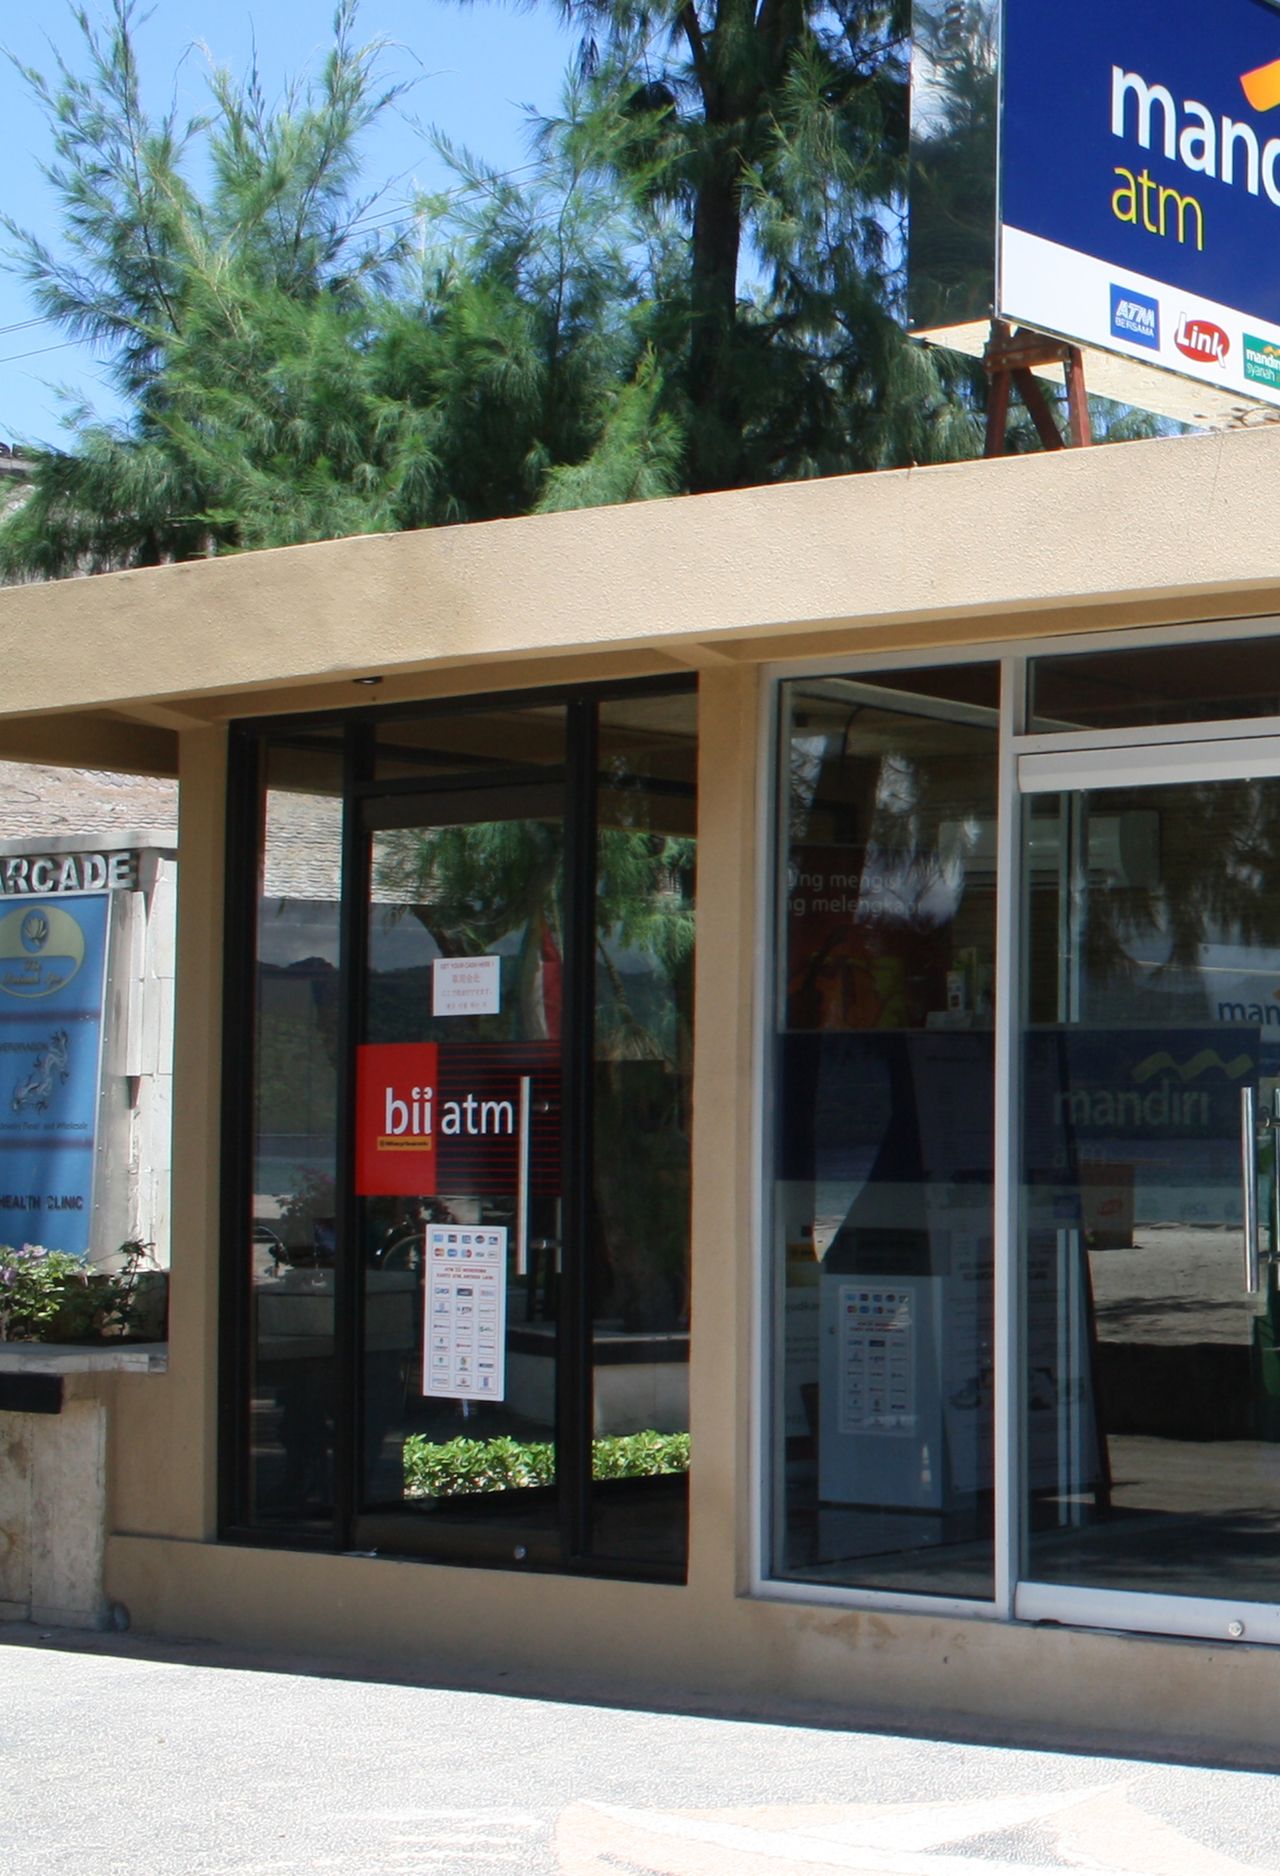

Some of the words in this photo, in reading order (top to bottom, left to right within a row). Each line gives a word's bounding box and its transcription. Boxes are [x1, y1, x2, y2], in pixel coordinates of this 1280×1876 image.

[1111, 166, 1205, 252] atm
[1115, 316, 1155, 338] BERSAMA
[1116, 300, 1155, 328] ATM
[1176, 311, 1226, 368] Link
[385, 1087, 433, 1135] bii
[441, 1093, 513, 1135] atm
[1053, 1079, 1209, 1127] mandiri
[47, 1195, 84, 1210] CLINIC
